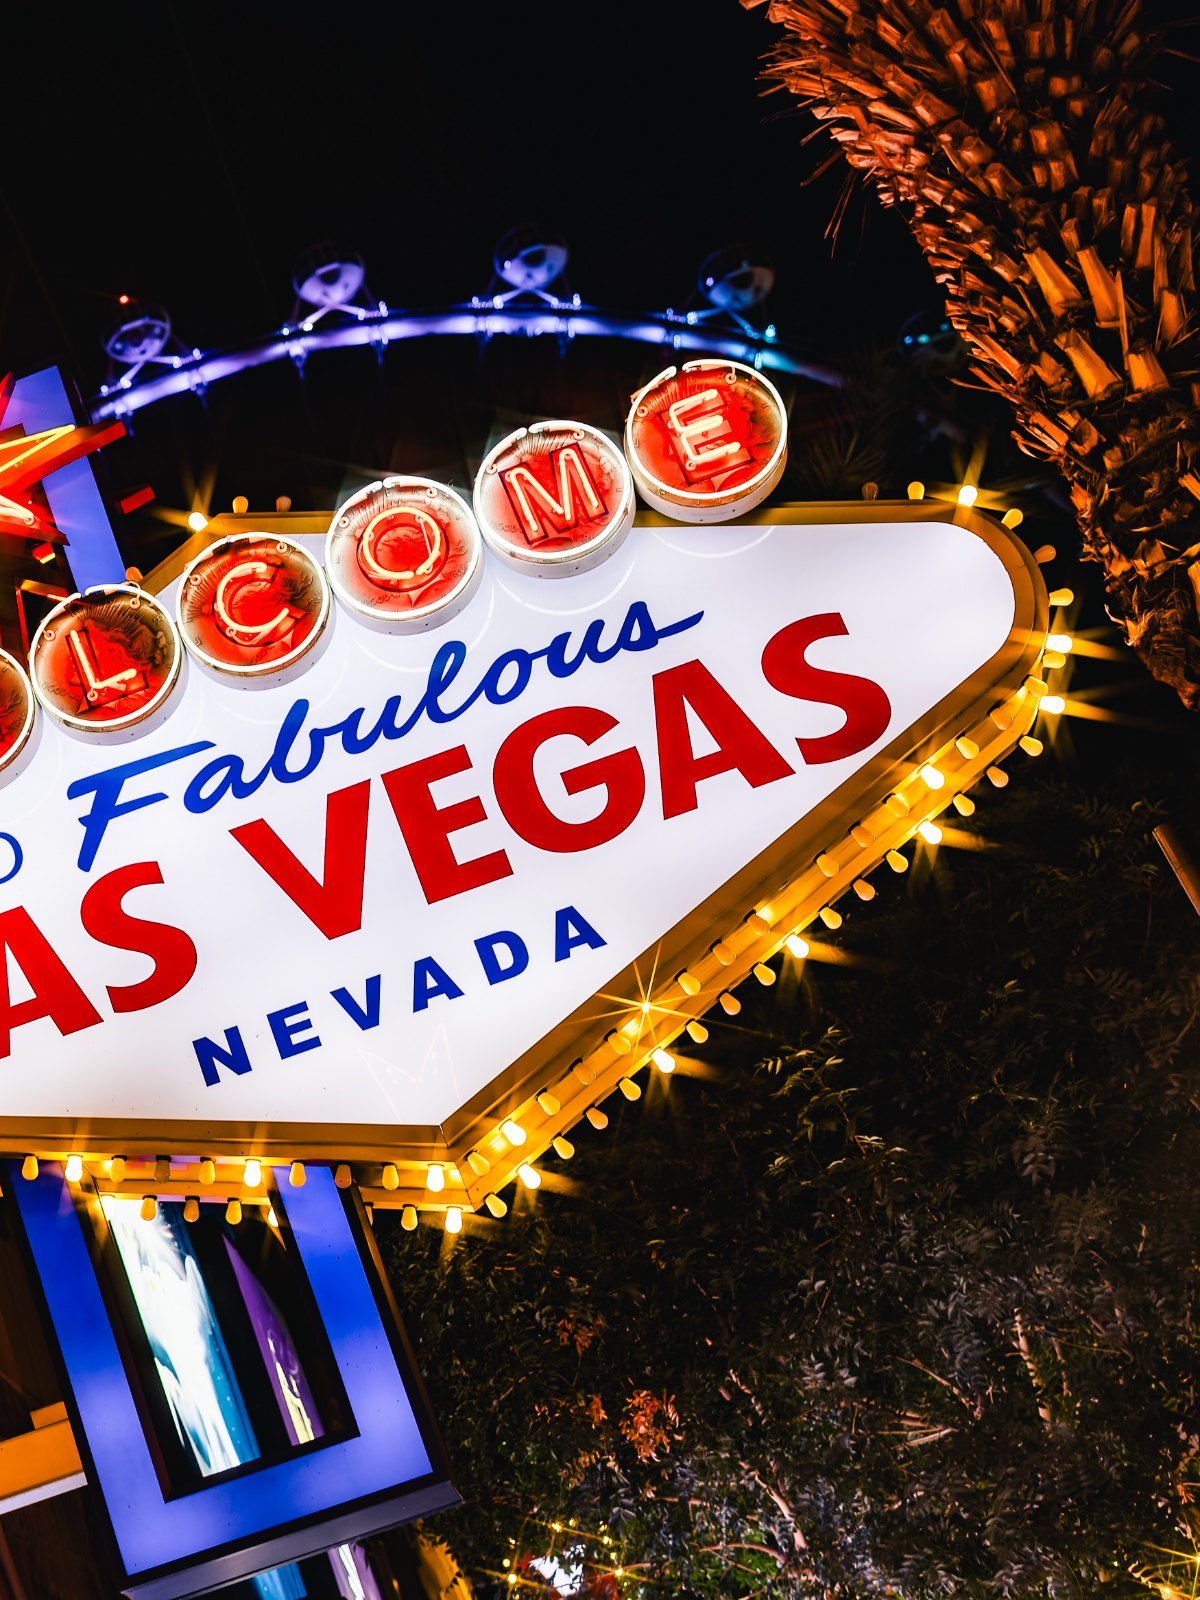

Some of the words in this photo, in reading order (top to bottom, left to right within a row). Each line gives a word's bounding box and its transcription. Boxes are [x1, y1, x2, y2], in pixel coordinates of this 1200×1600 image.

[66, 600, 705, 873] Fabulous
[229, 613, 891, 940] VEGAS
[192, 905, 608, 1087] NEVADA
